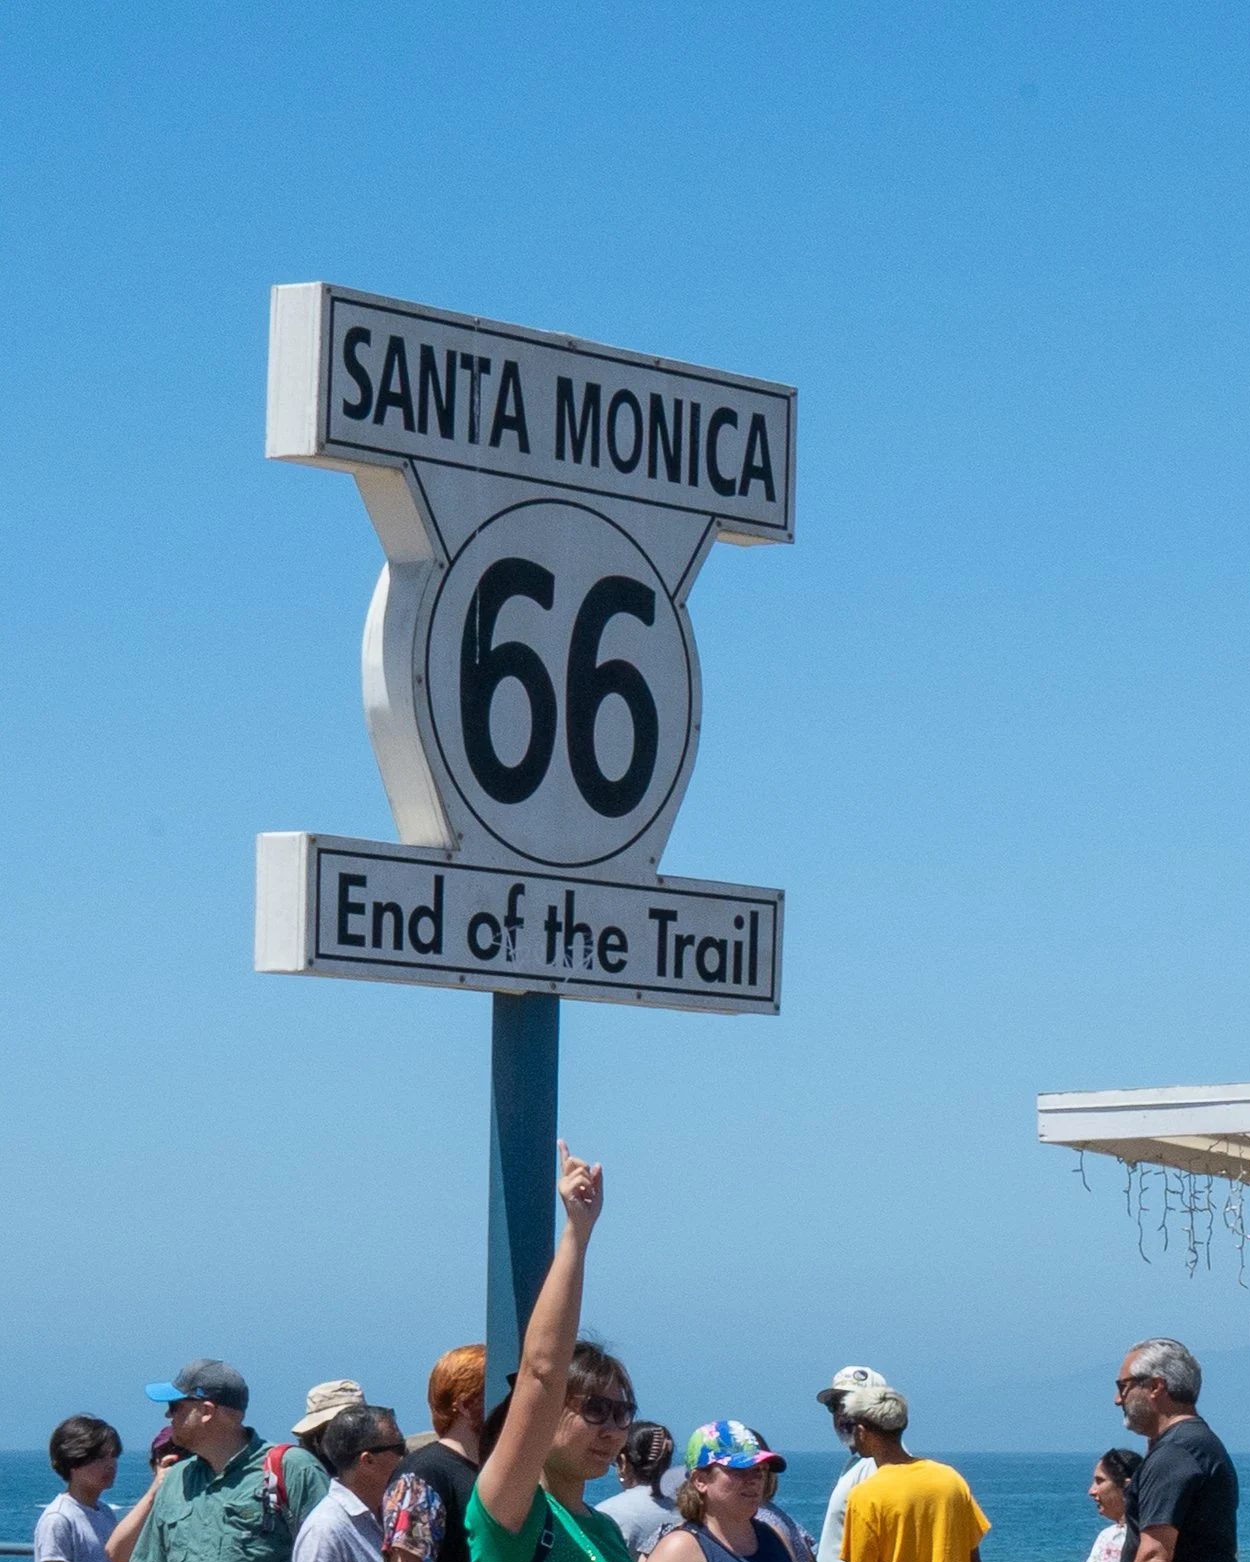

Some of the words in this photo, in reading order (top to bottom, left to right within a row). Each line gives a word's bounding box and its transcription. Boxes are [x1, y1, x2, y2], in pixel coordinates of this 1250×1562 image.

[342, 326, 531, 455] SANTA
[555, 376, 777, 502] MONICA
[460, 557, 659, 819] 66
[338, 872, 444, 955] End
[467, 882, 525, 961] of
[544, 889, 629, 974] the
[648, 907, 759, 986] Trail
